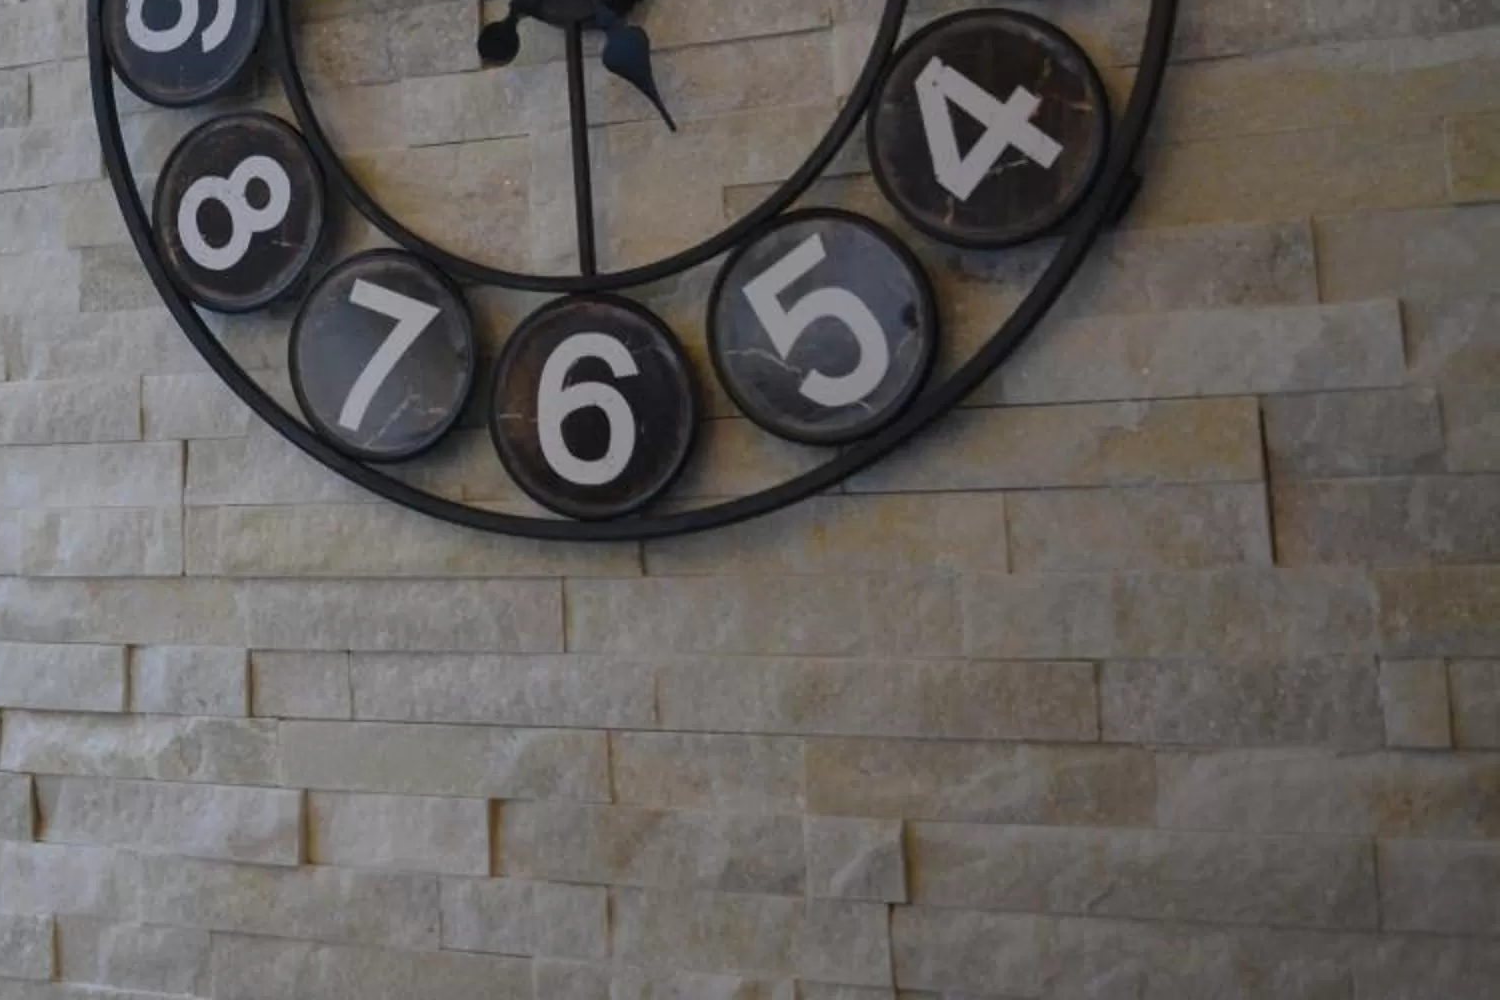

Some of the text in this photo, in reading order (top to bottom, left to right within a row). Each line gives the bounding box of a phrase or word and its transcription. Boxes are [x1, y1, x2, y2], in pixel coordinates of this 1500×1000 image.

[914, 55, 1064, 202] 4
[177, 155, 291, 271] 8
[337, 278, 440, 432] 7
[742, 232, 889, 407] 5
[536, 332, 639, 485] 6
